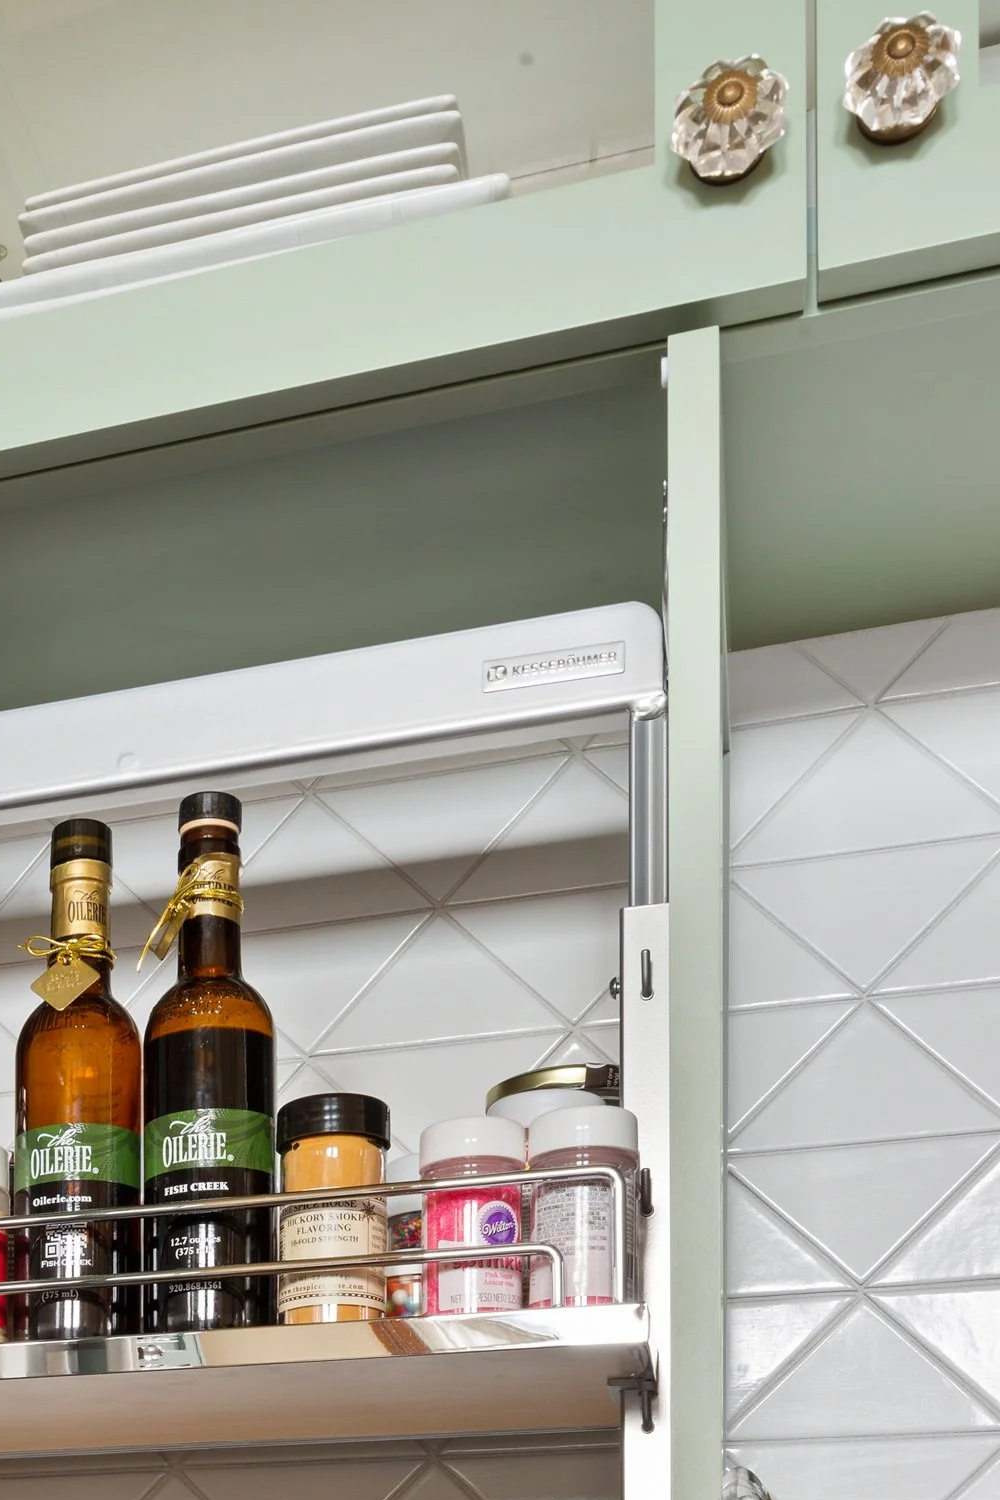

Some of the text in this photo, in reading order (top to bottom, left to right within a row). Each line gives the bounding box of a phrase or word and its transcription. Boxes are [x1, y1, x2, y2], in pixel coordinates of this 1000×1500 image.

[512, 650, 617, 675] KESSEBÖHMER
[37, 1128, 82, 1148] the
[162, 1132, 227, 1168] OILERIE
[31, 1146, 92, 1179] OILERIE
[164, 1181, 229, 1196] FISH CREEK
[32, 1194, 92, 1207] Oilerie.com
[287, 1212, 364, 1227] HICKORY SMOKE
[296, 1223, 352, 1236] FLAVORING
[482, 1220, 515, 1237] Wilton
[170, 1236, 221, 1247] 12.7 oues
[41, 1260, 59, 1268] FISH
[169, 1281, 222, 1294] 920.868.1561
